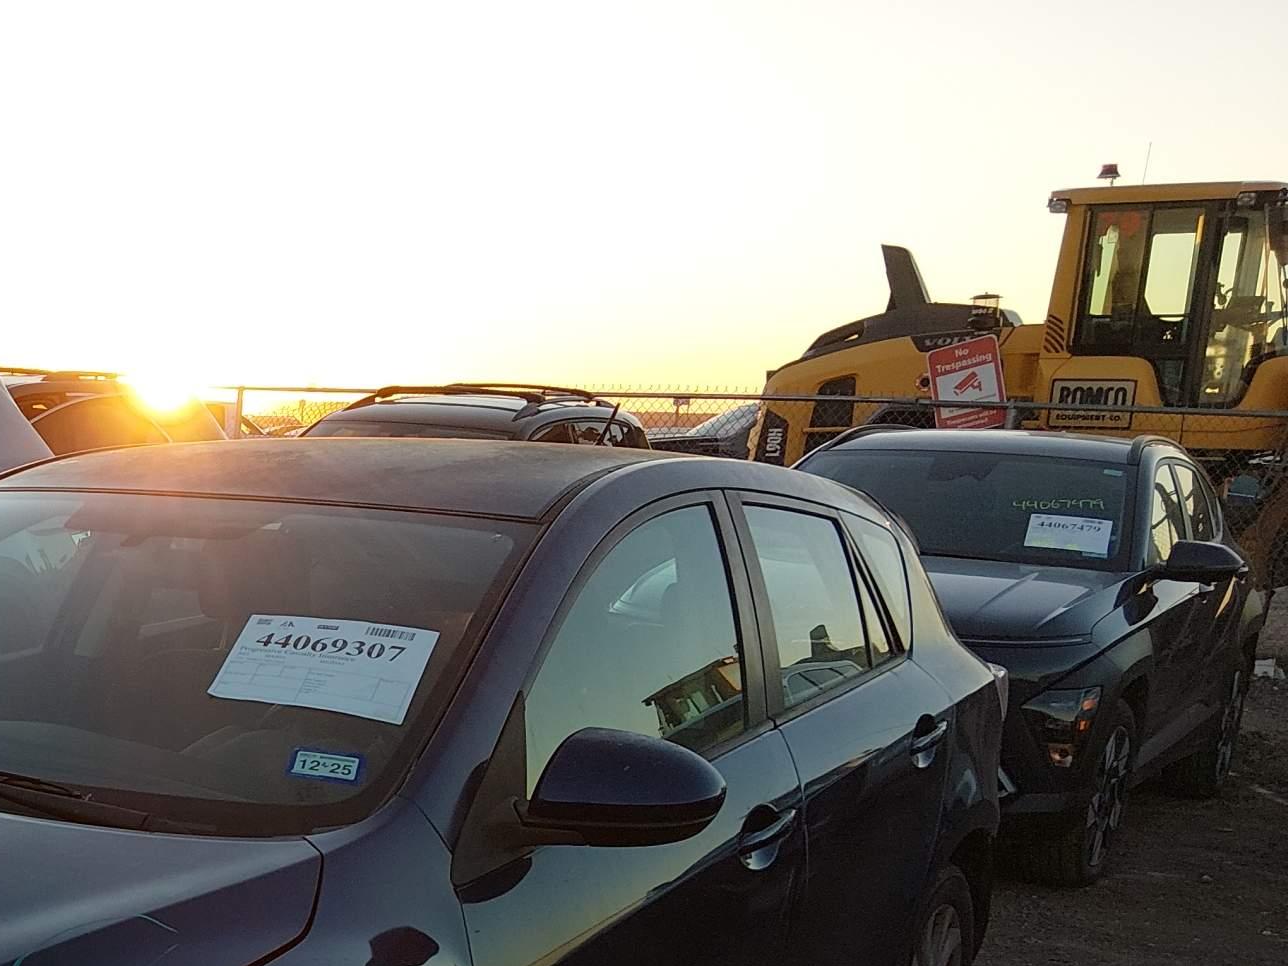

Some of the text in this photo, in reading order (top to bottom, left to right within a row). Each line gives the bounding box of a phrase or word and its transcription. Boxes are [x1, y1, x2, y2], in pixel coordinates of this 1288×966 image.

[955, 348, 969, 357] No
[935, 353, 992, 373] Trespassing
[1059, 386, 1128, 406] ROMCO
[1056, 413, 1106, 421] EQUIPMENT
[765, 428, 783, 457] L90H
[1038, 521, 1102, 533] 44067479
[256, 632, 407, 663] 44069307
